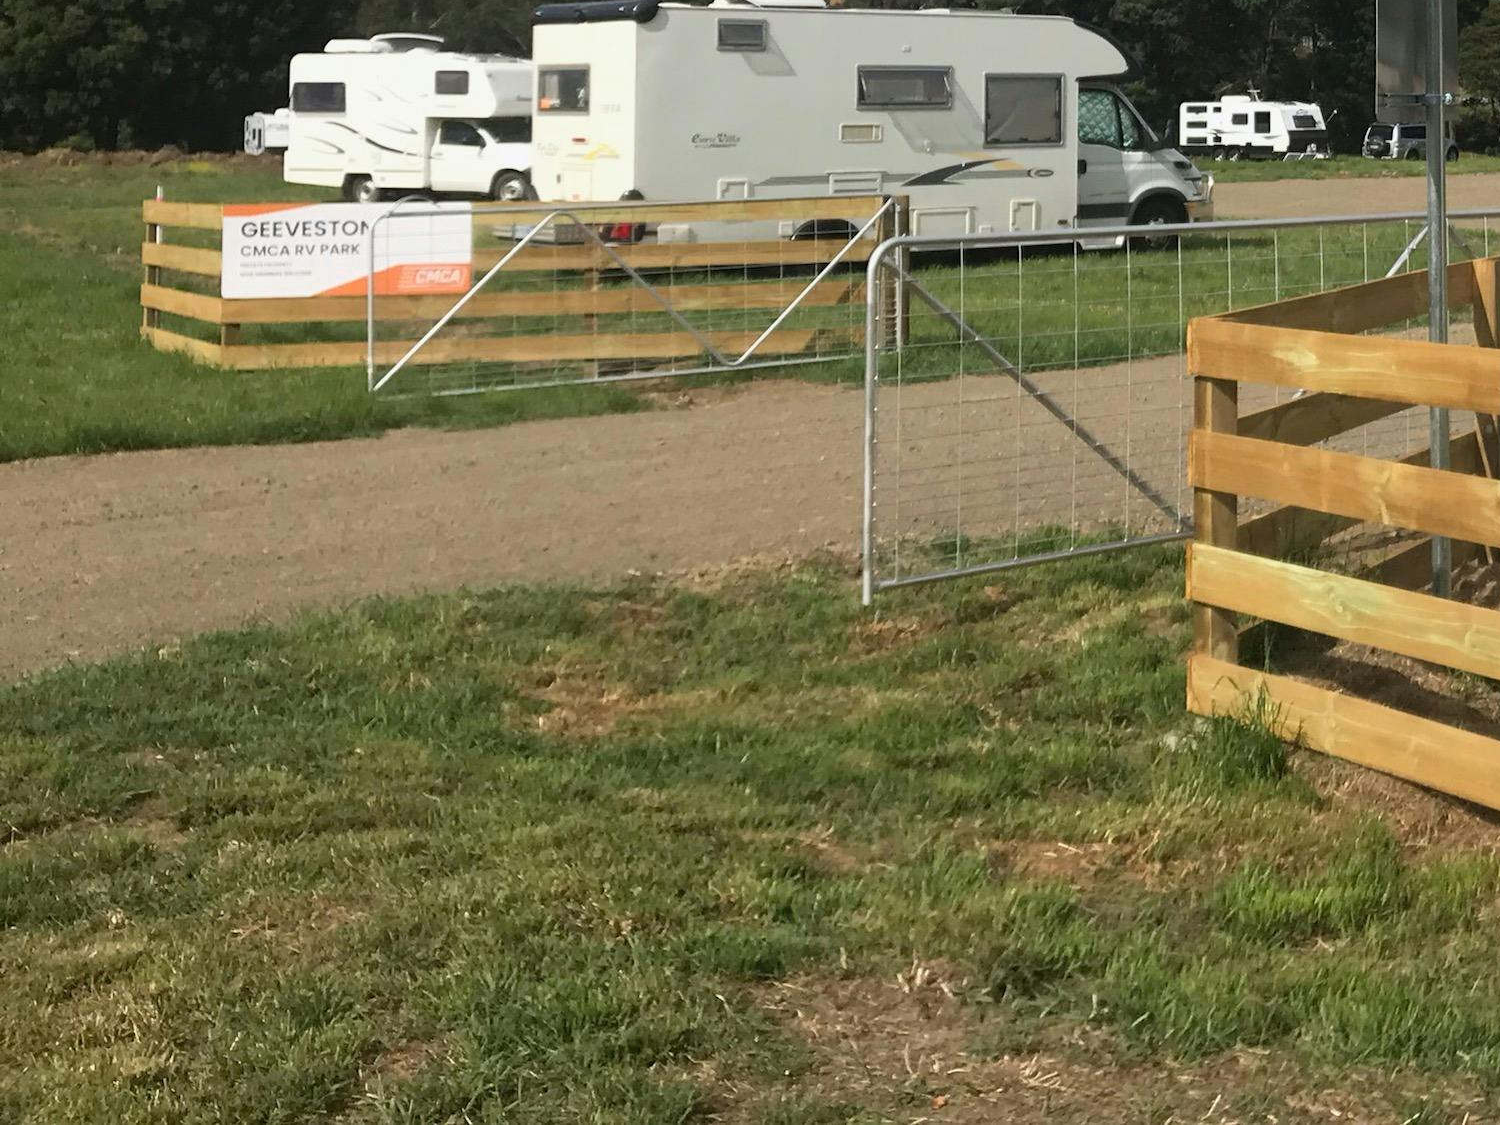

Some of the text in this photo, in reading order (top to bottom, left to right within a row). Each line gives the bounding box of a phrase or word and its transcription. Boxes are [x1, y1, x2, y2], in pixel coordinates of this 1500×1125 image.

[241, 243, 360, 257] CMCA RV PARK
[416, 269, 461, 284] CMCA
